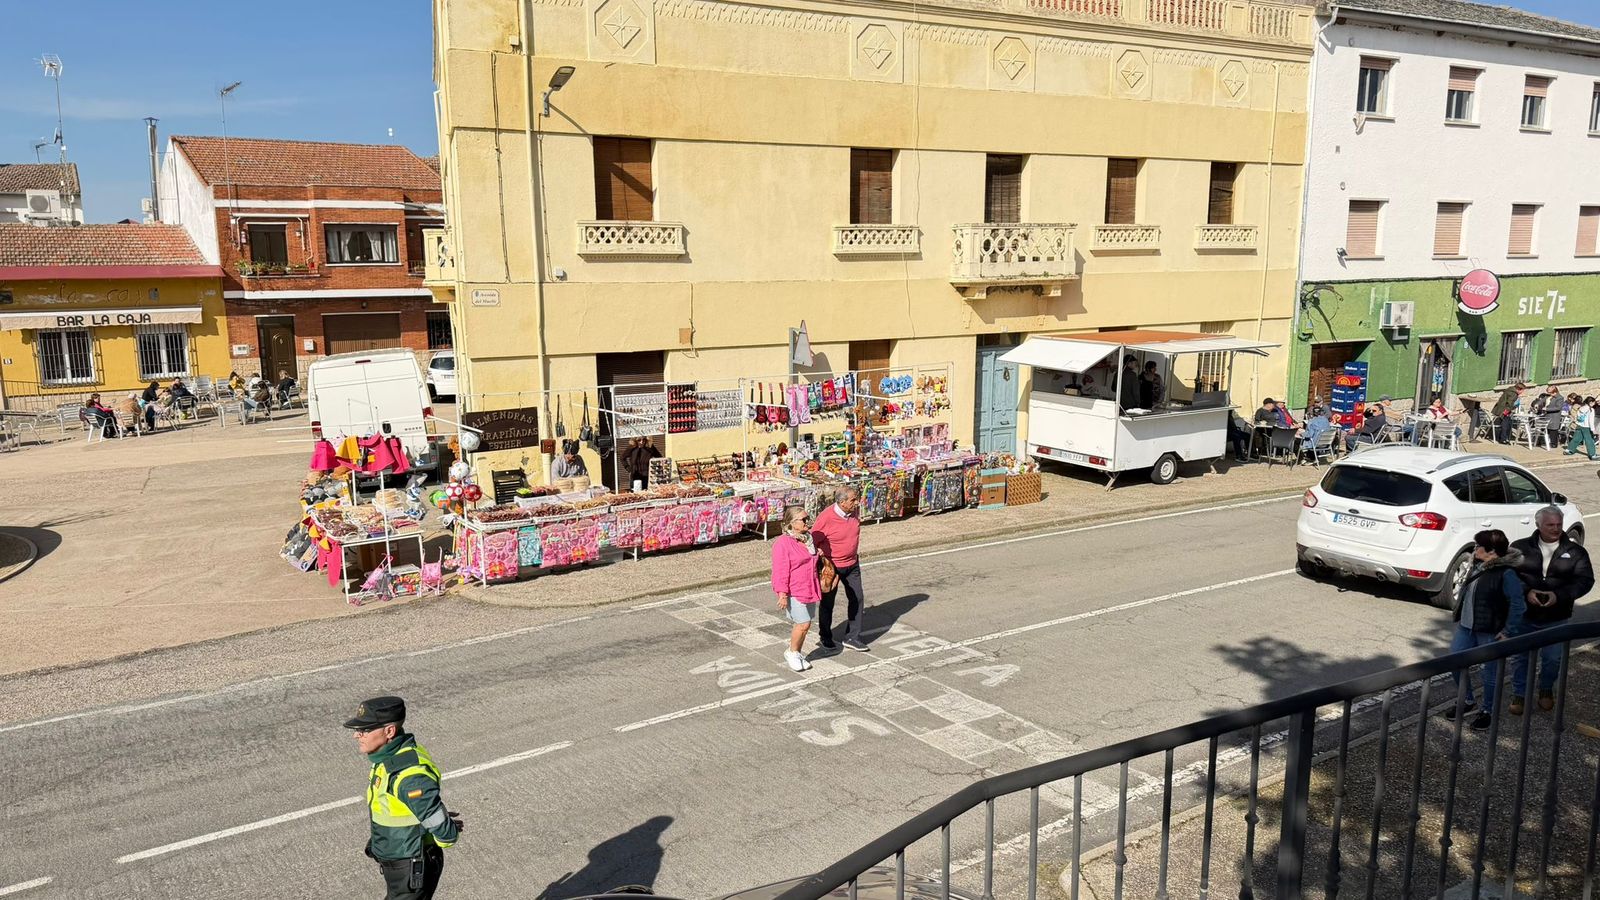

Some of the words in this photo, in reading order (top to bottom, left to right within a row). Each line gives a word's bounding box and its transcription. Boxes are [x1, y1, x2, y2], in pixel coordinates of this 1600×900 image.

[1461, 281, 1496, 297] Coca-Cola
[1518, 290, 1567, 320] SIE7E
[57, 315, 84, 326] BAR
[92, 314, 110, 325] LA
[117, 313, 151, 324] CAJA
[472, 411, 534, 429] ALMENDRAS
[480, 427, 538, 441] RRAPIÑADAS
[488, 440, 522, 450] ESTHER
[1360, 518, 1376, 529] GVP
